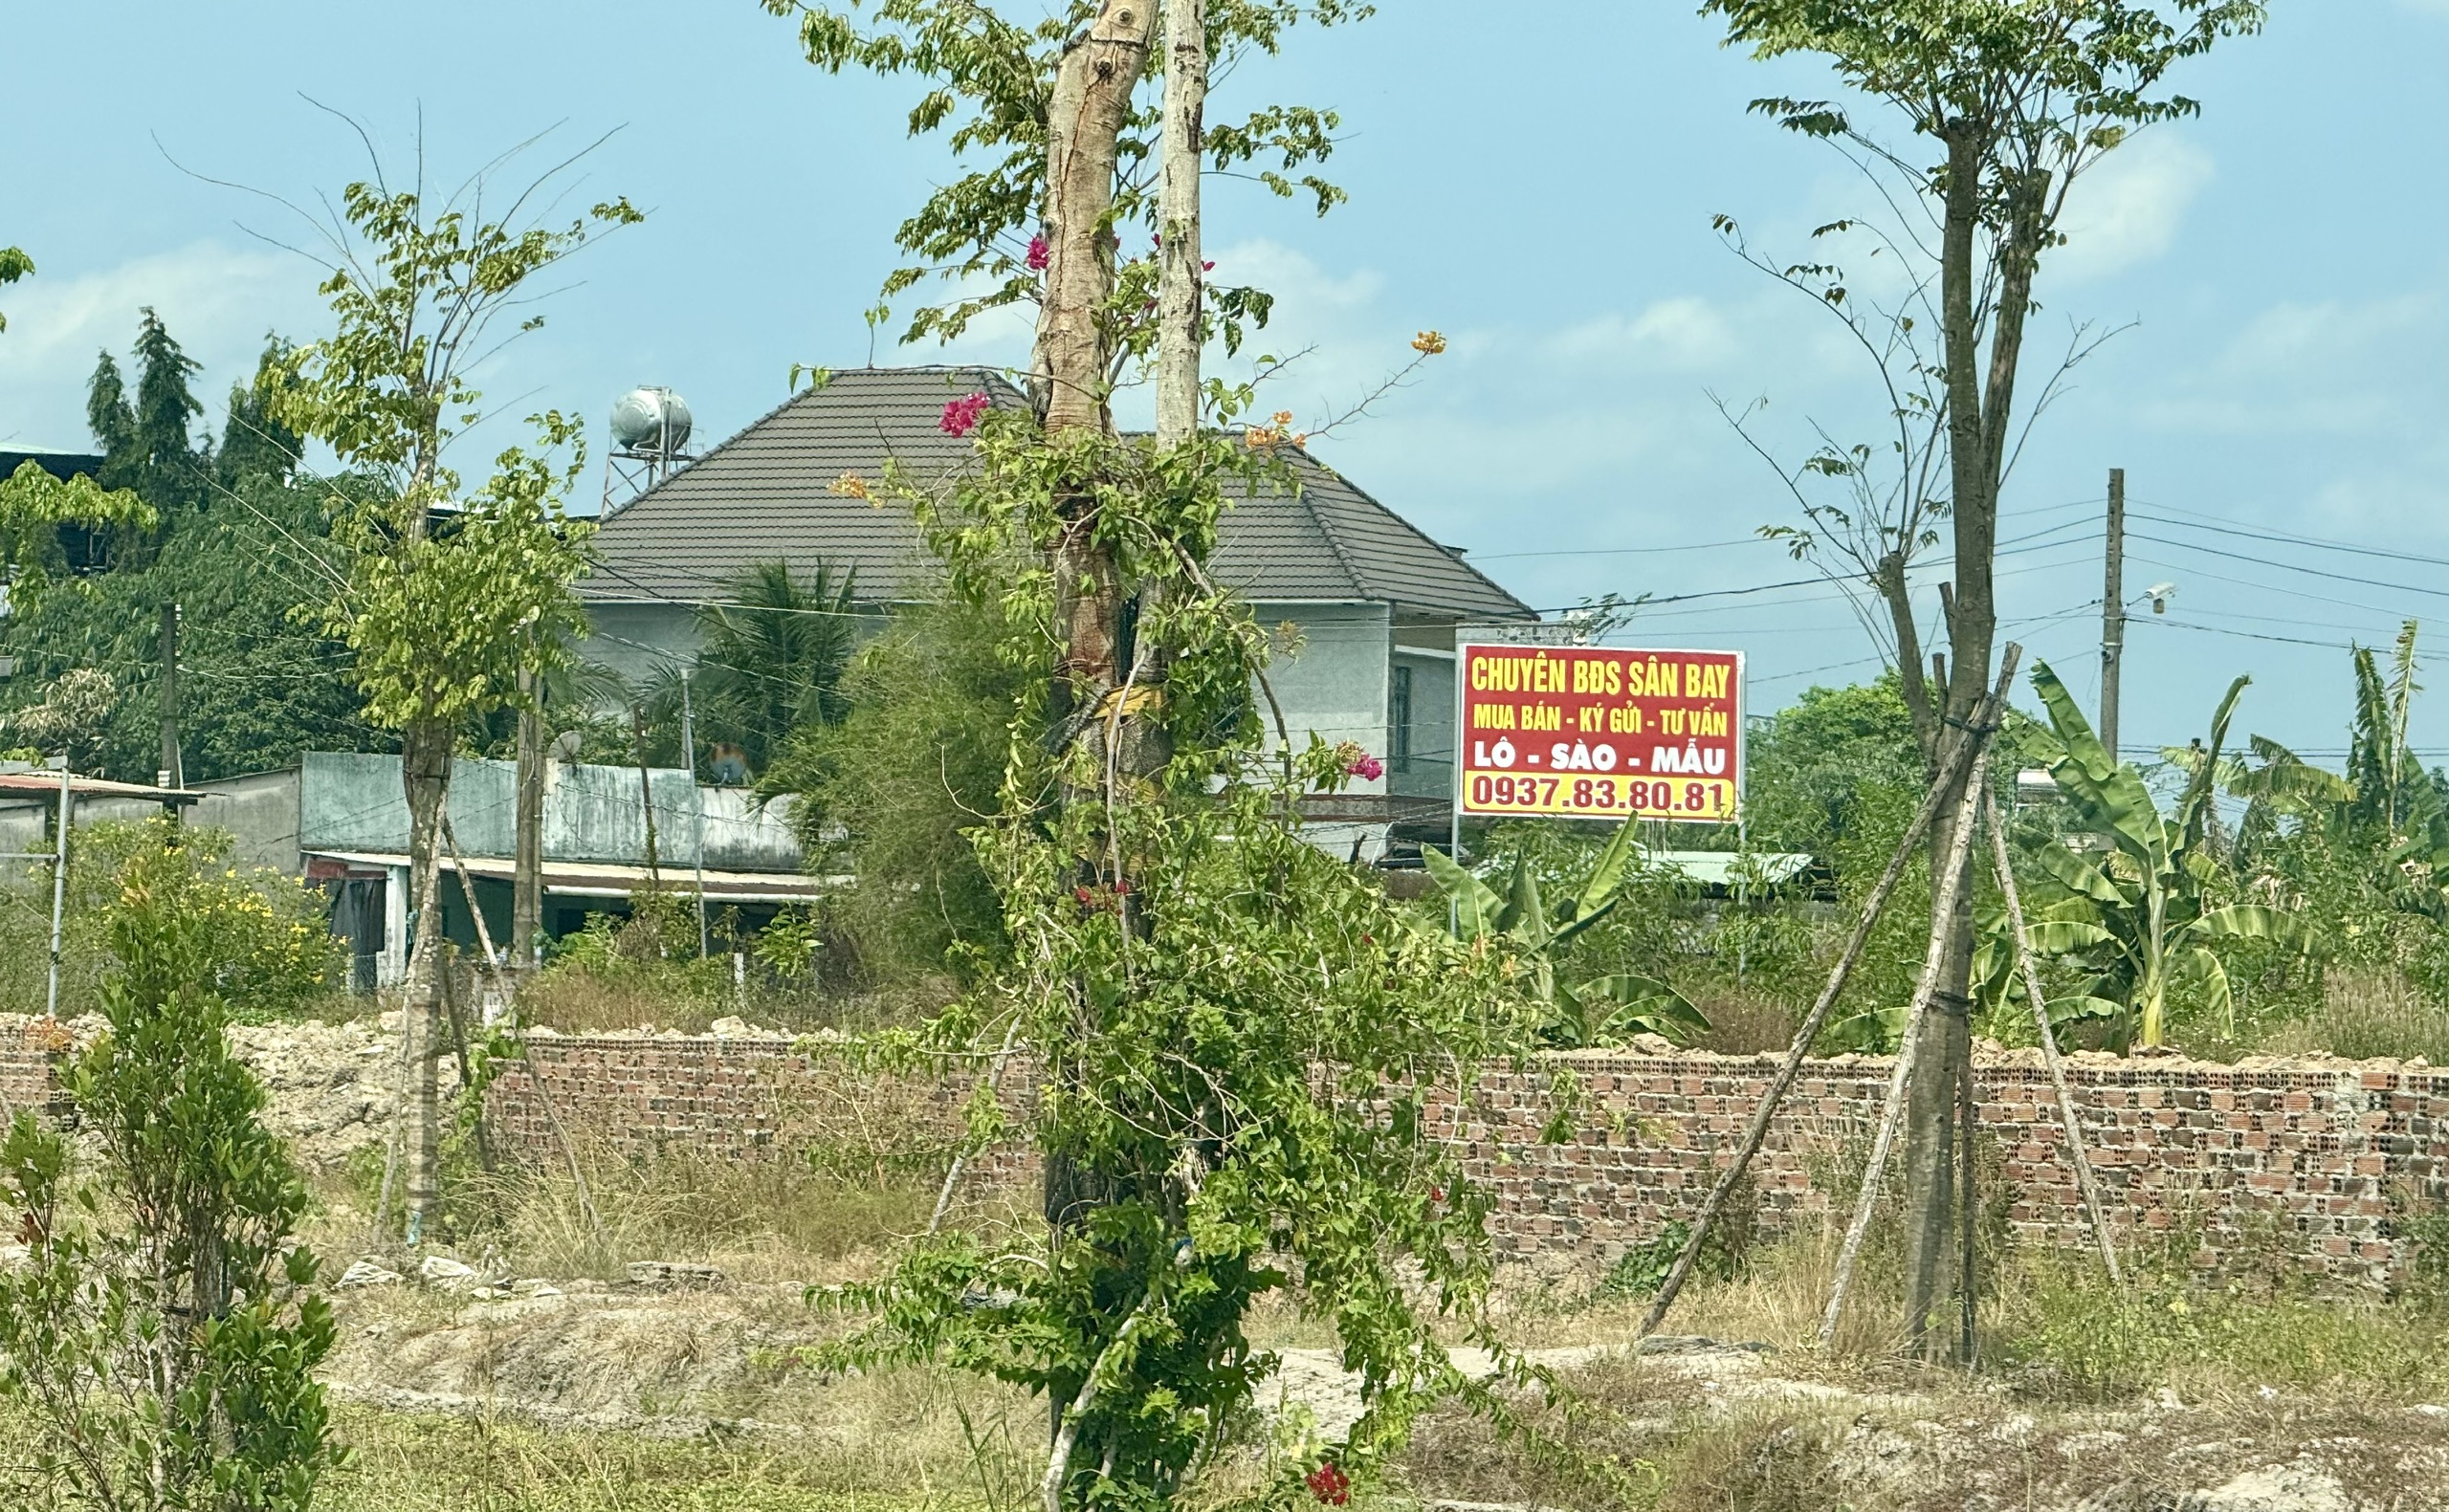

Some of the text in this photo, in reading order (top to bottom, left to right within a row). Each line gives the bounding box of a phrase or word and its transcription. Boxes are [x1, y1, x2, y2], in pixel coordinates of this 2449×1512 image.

[1471, 650, 1731, 699] CHUYÊN BĐS SÂN BAY
[1473, 704, 1516, 730] MUA
[1521, 700, 1560, 731] BÁN
[1579, 702, 1604, 733] KÝ
[1609, 700, 1642, 734] GỬI
[1660, 708, 1686, 734] TƯ
[1688, 702, 1728, 736] VẤN
[1474, 735, 1726, 775] LÔ - SÀO - MẪU
[1472, 775, 1723, 812] 0937.83.80.81
